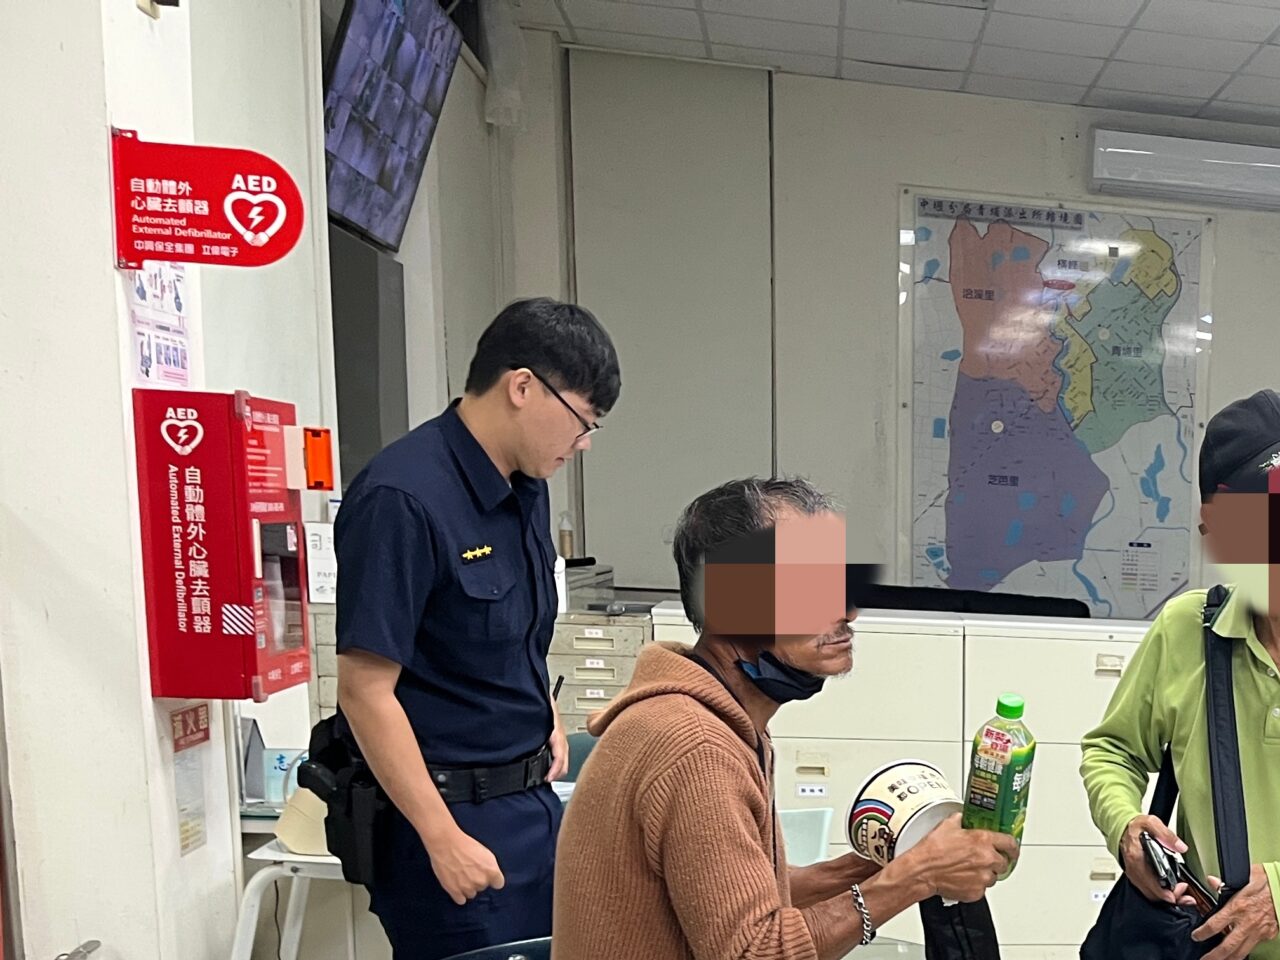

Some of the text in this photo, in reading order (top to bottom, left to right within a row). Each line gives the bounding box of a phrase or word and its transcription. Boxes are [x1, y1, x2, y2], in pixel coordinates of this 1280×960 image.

[130, 177, 192, 196] 自動體外
[231, 173, 277, 192] AED
[132, 214, 187, 227] Automated
[132, 225, 232, 240] External Defibrillator
[165, 407, 198, 420] AED
[168, 464, 188, 633] Automated External Defibrillator
